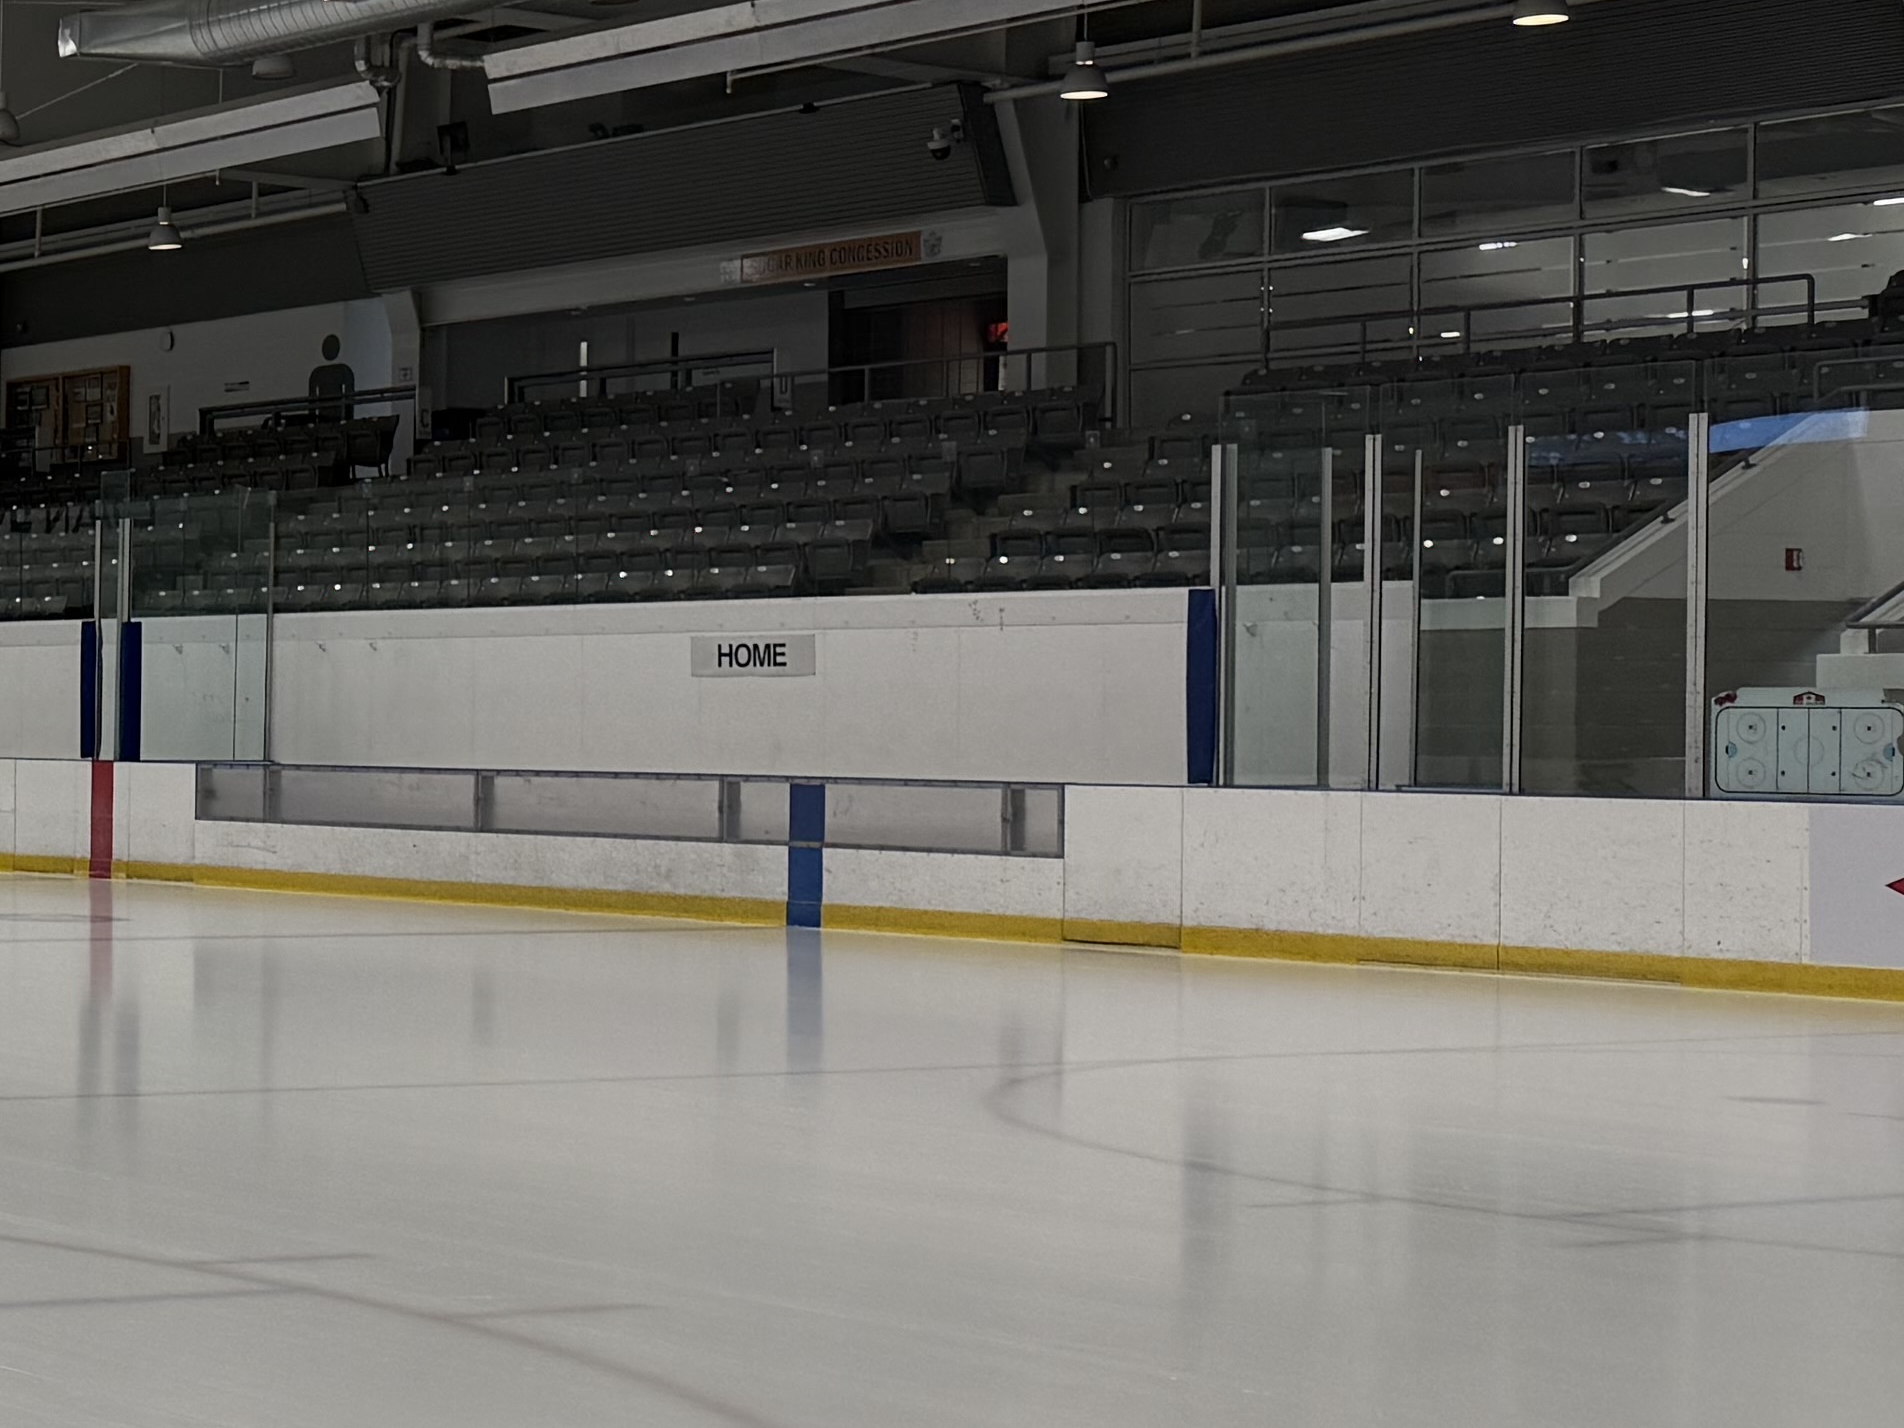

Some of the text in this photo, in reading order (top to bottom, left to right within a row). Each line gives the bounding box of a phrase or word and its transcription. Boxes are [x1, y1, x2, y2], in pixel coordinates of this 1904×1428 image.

[795, 251, 826, 268] KING
[830, 239, 913, 266] CONCESSION
[718, 643, 787, 668] HOME
